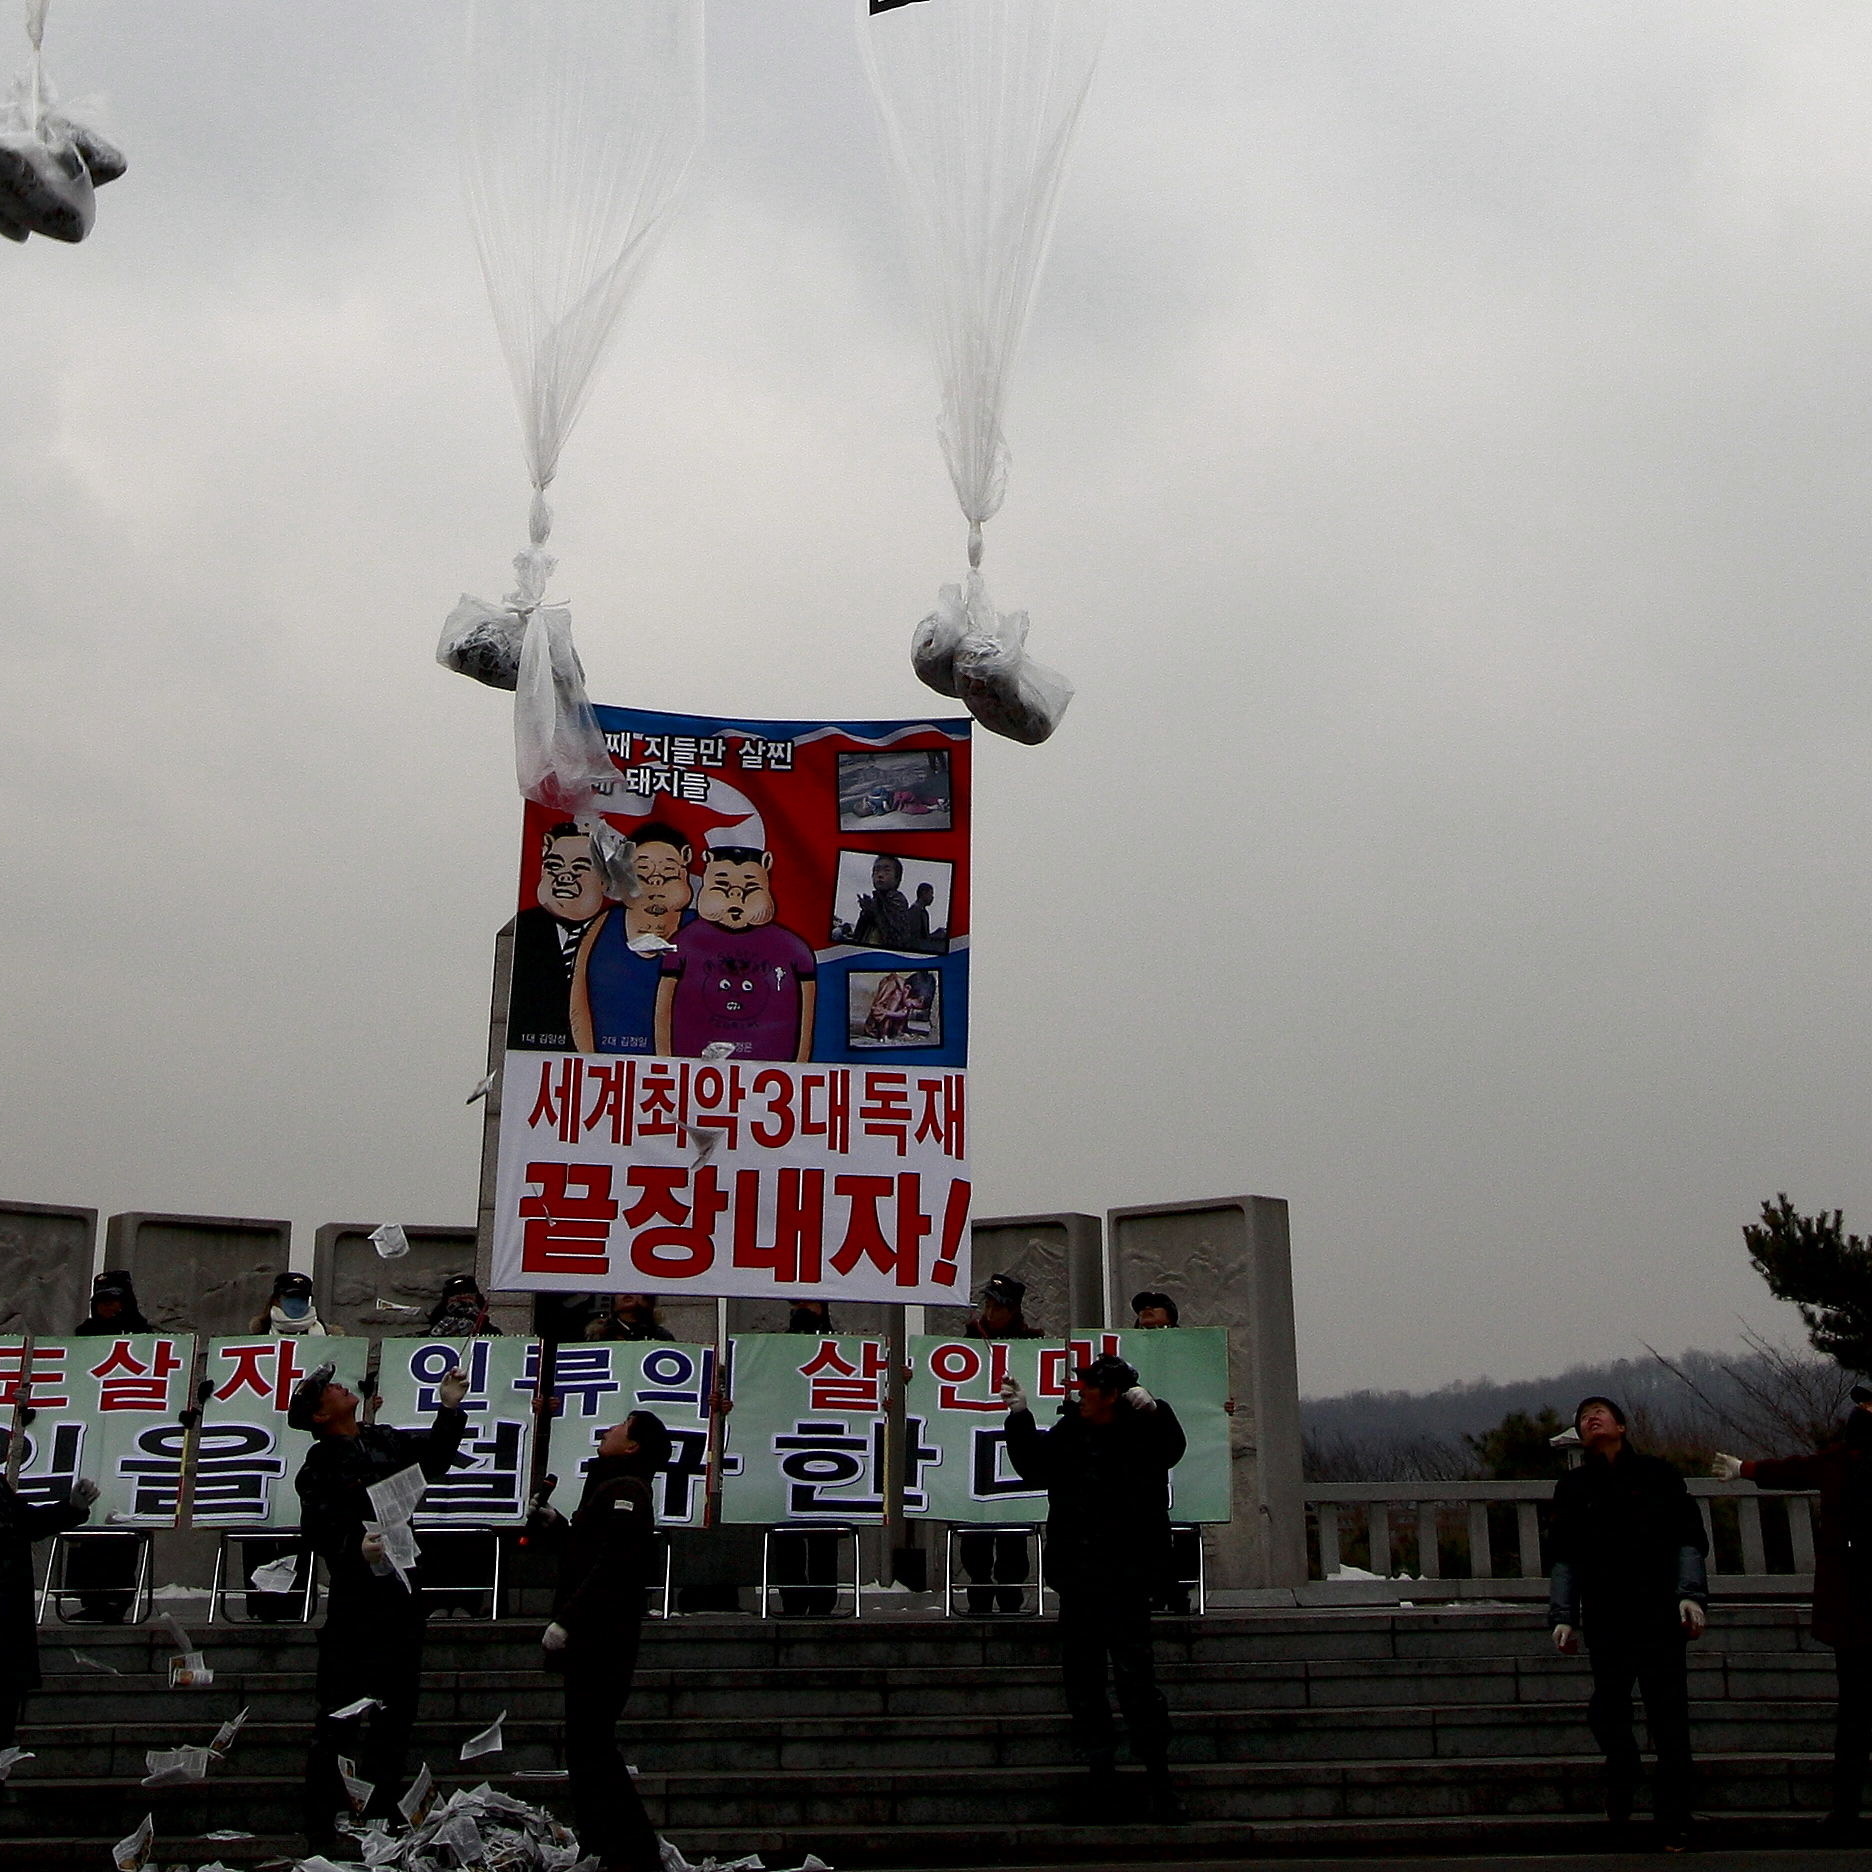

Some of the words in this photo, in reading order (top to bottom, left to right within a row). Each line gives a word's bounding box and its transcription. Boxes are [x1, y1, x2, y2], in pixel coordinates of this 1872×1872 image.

[643, 735, 726, 767] 지들만
[738, 739, 792, 769] 살찐
[626, 768, 708, 800] 돼지들
[520, 1032, 535, 1044] 1대
[539, 1033, 566, 1046] 김일성
[601, 1035, 617, 1046] 2대
[620, 1036, 648, 1048] 김정일
[517, 1162, 972, 1288] 끝장내자!
[409, 1339, 735, 1418] 인류의
